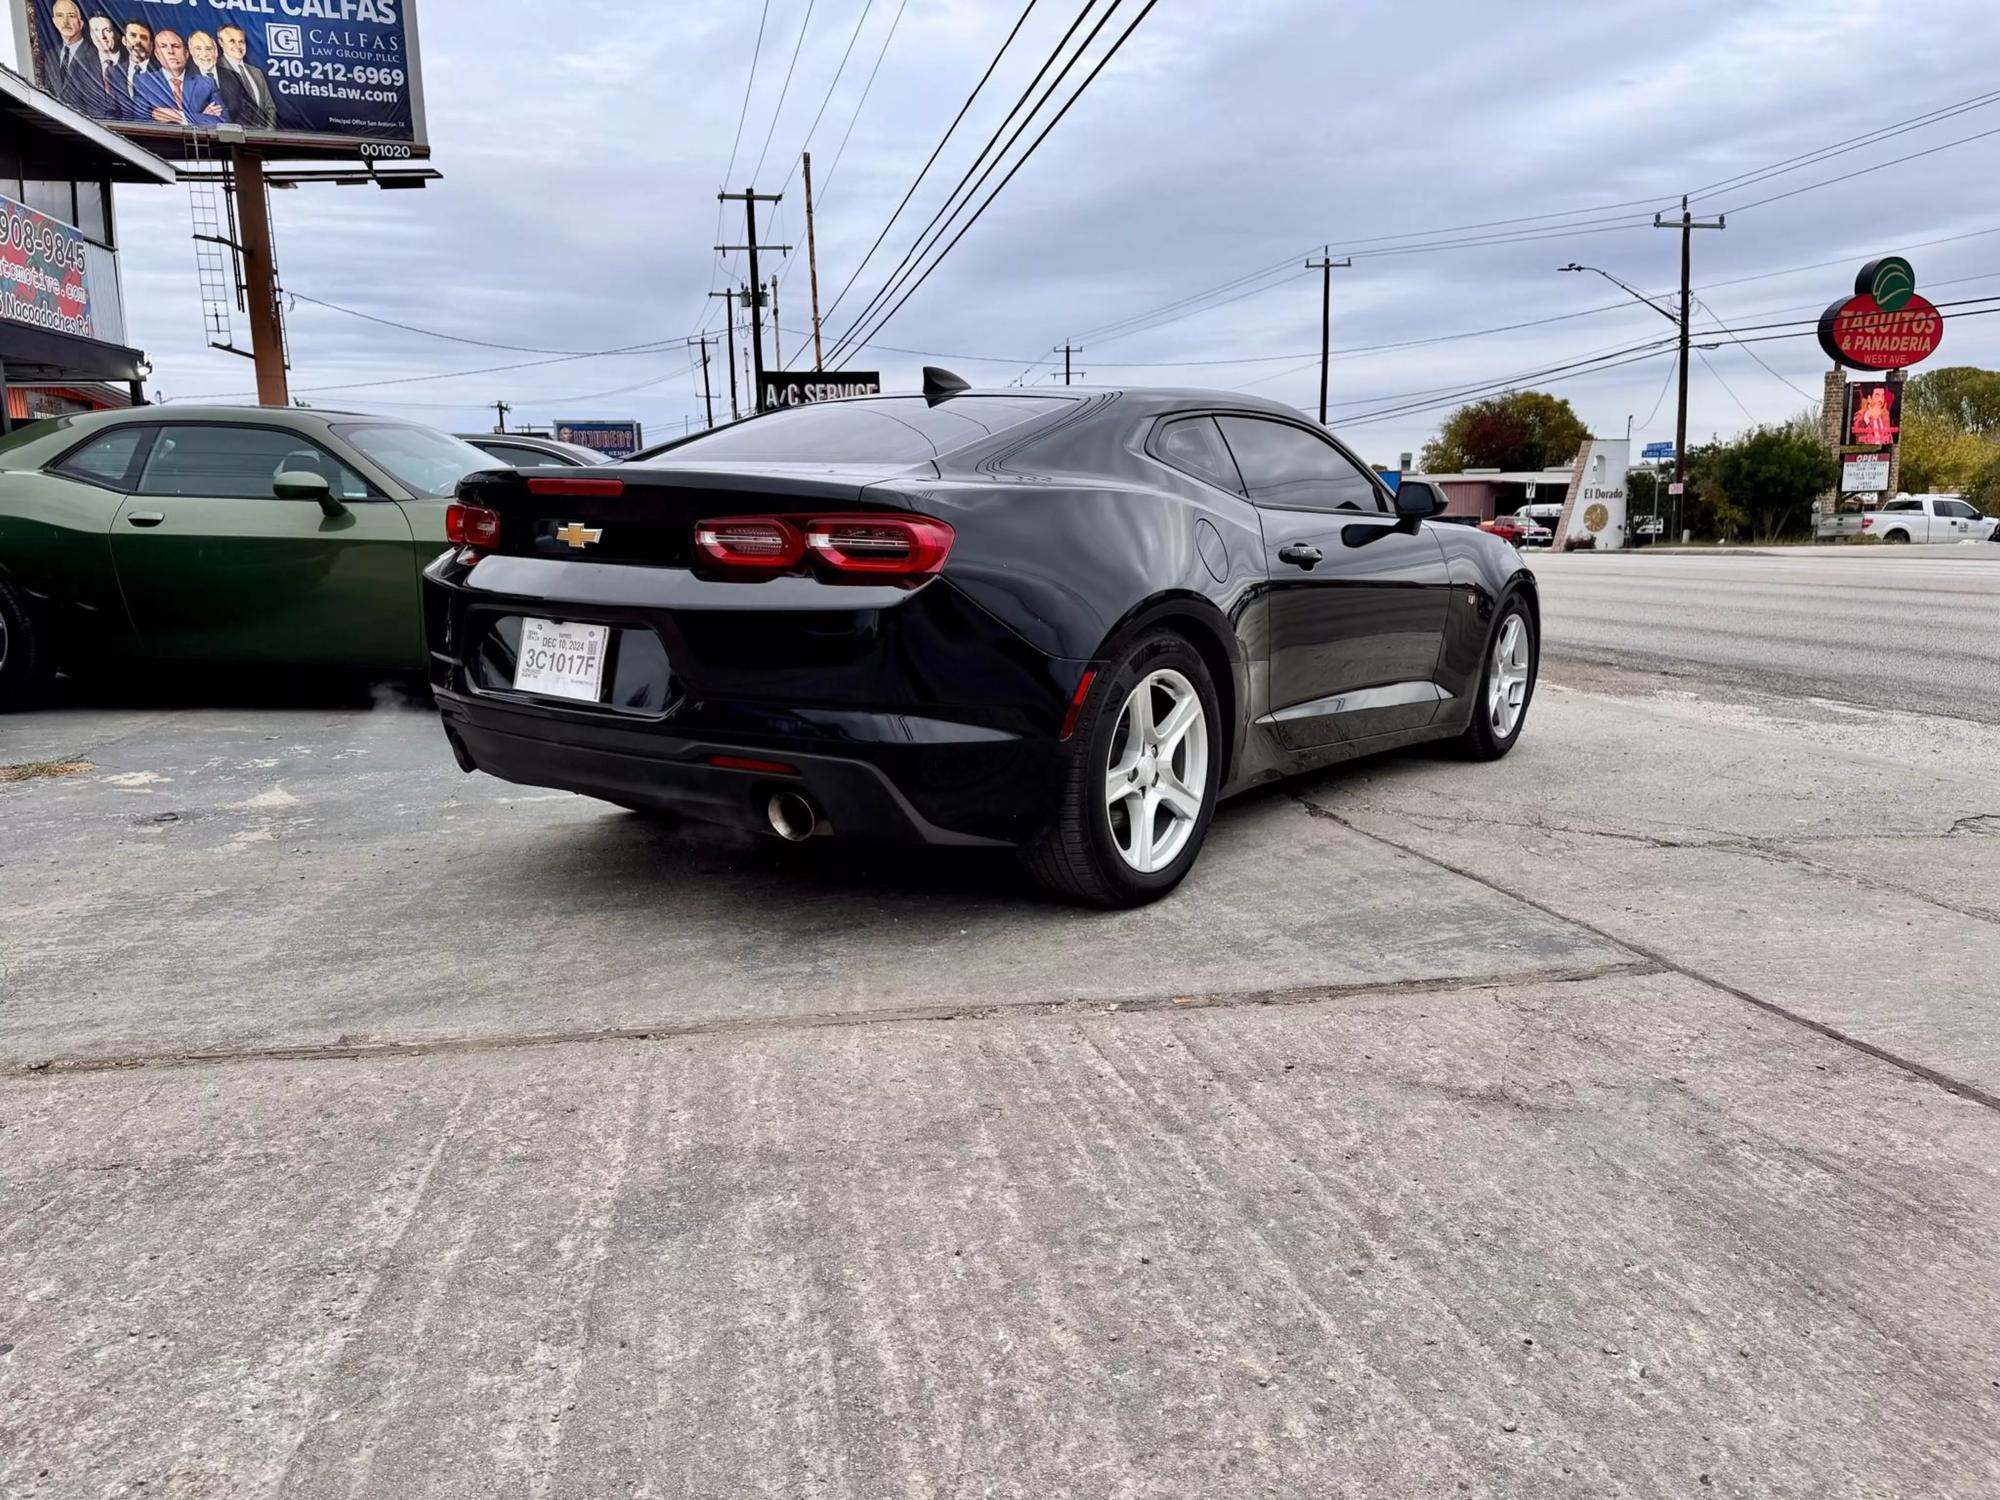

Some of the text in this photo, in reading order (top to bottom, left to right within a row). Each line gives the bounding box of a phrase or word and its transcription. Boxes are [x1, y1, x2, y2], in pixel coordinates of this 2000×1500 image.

[280, 0, 397, 24] CALFAS
[309, 29, 400, 50] CALFAS
[311, 47, 328, 56] LAW
[266, 58, 405, 86] 210-212-6969
[278, 79, 398, 103] CalfasLaw.com
[360, 143, 410, 158] 001020
[0, 255, 87, 304] tomotive.com
[77, 314, 91, 337] Rd
[1839, 310, 1937, 335] TAQUITOS
[1841, 335, 1931, 351] & PANADERIA
[1863, 354, 1887, 363] WEST
[766, 383, 799, 406] A/C
[1856, 454, 1878, 463] OPEN
[1584, 488, 1623, 499] El Dorado
[542, 637, 557, 648] DEC
[569, 640, 585, 651] 2024
[526, 648, 595, 676] 3C1017F
